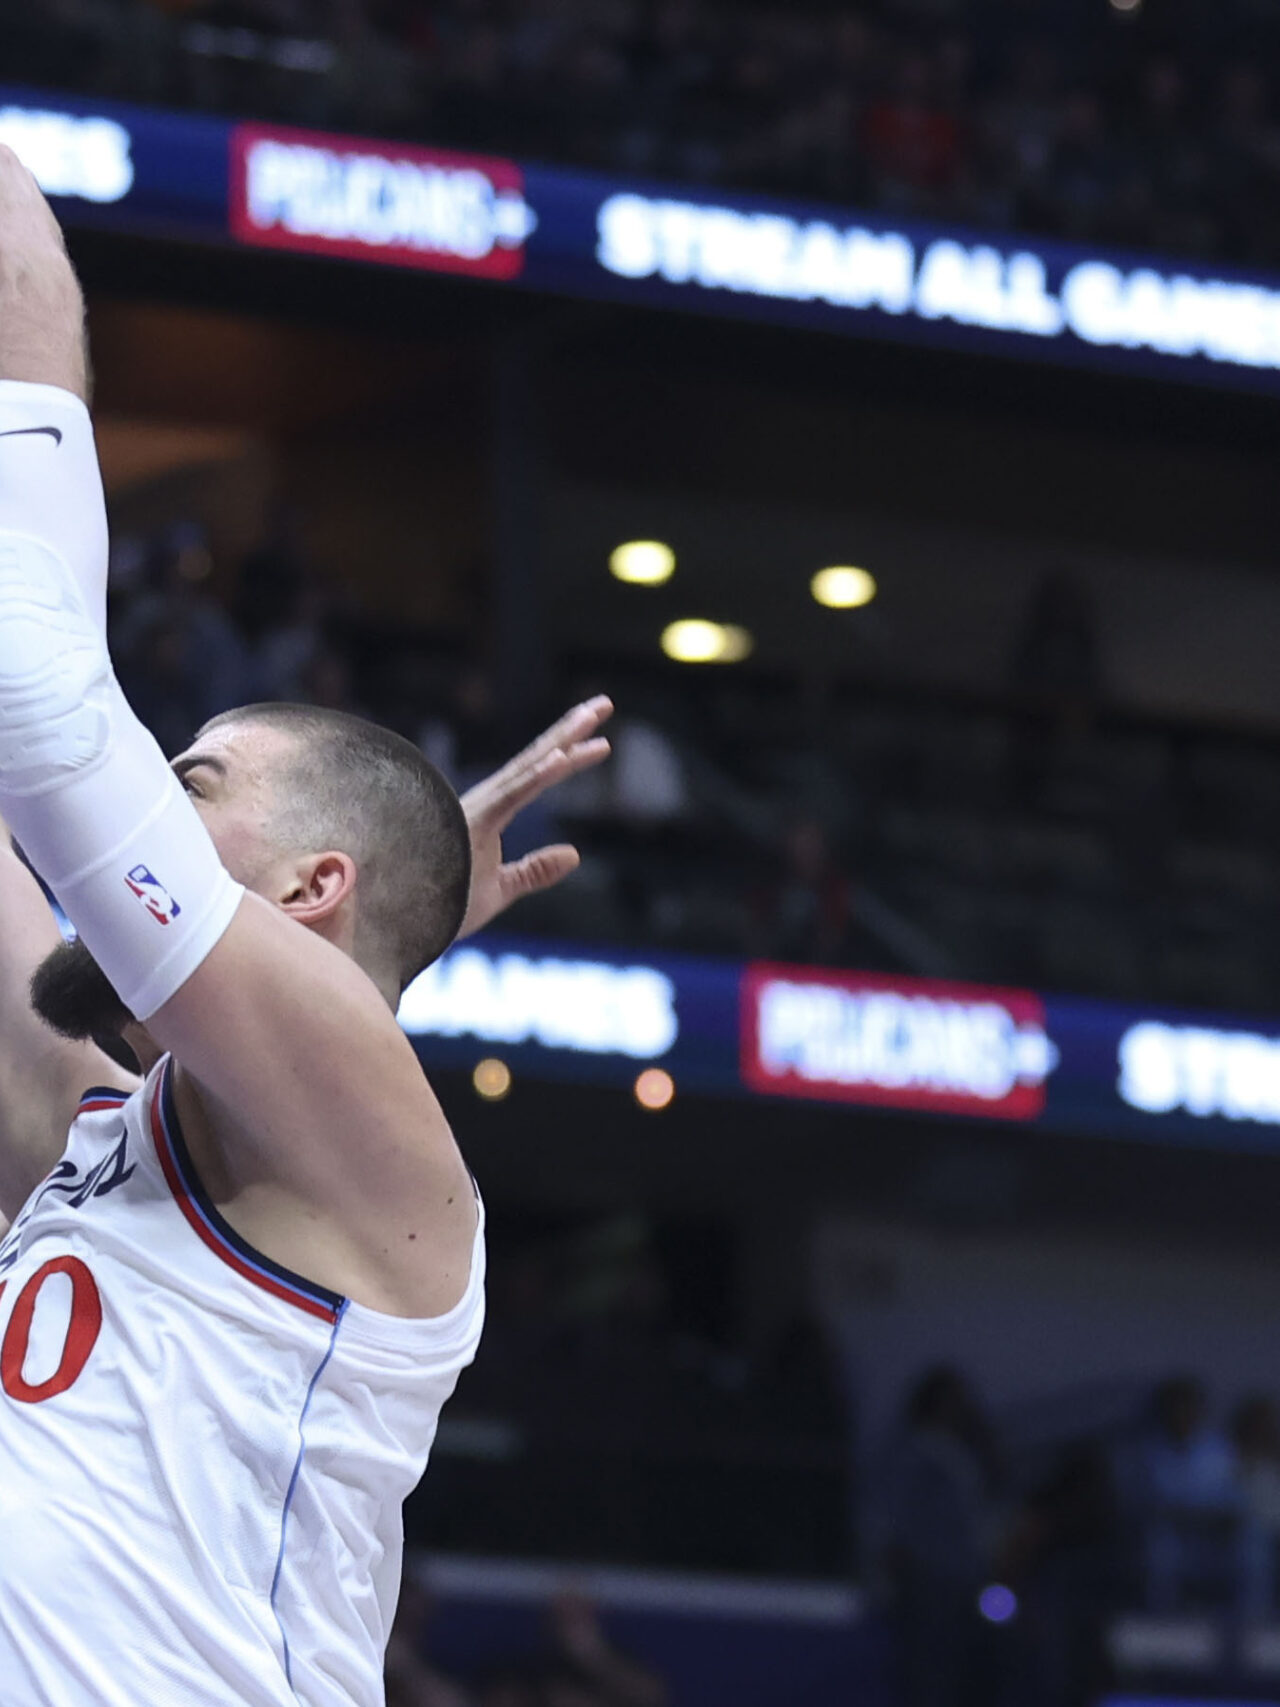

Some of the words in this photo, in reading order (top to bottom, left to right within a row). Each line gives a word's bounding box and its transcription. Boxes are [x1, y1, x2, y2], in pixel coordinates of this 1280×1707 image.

[596, 192, 914, 315] STREAM
[916, 239, 1064, 338] ALL
[1062, 261, 1280, 370] GAME
